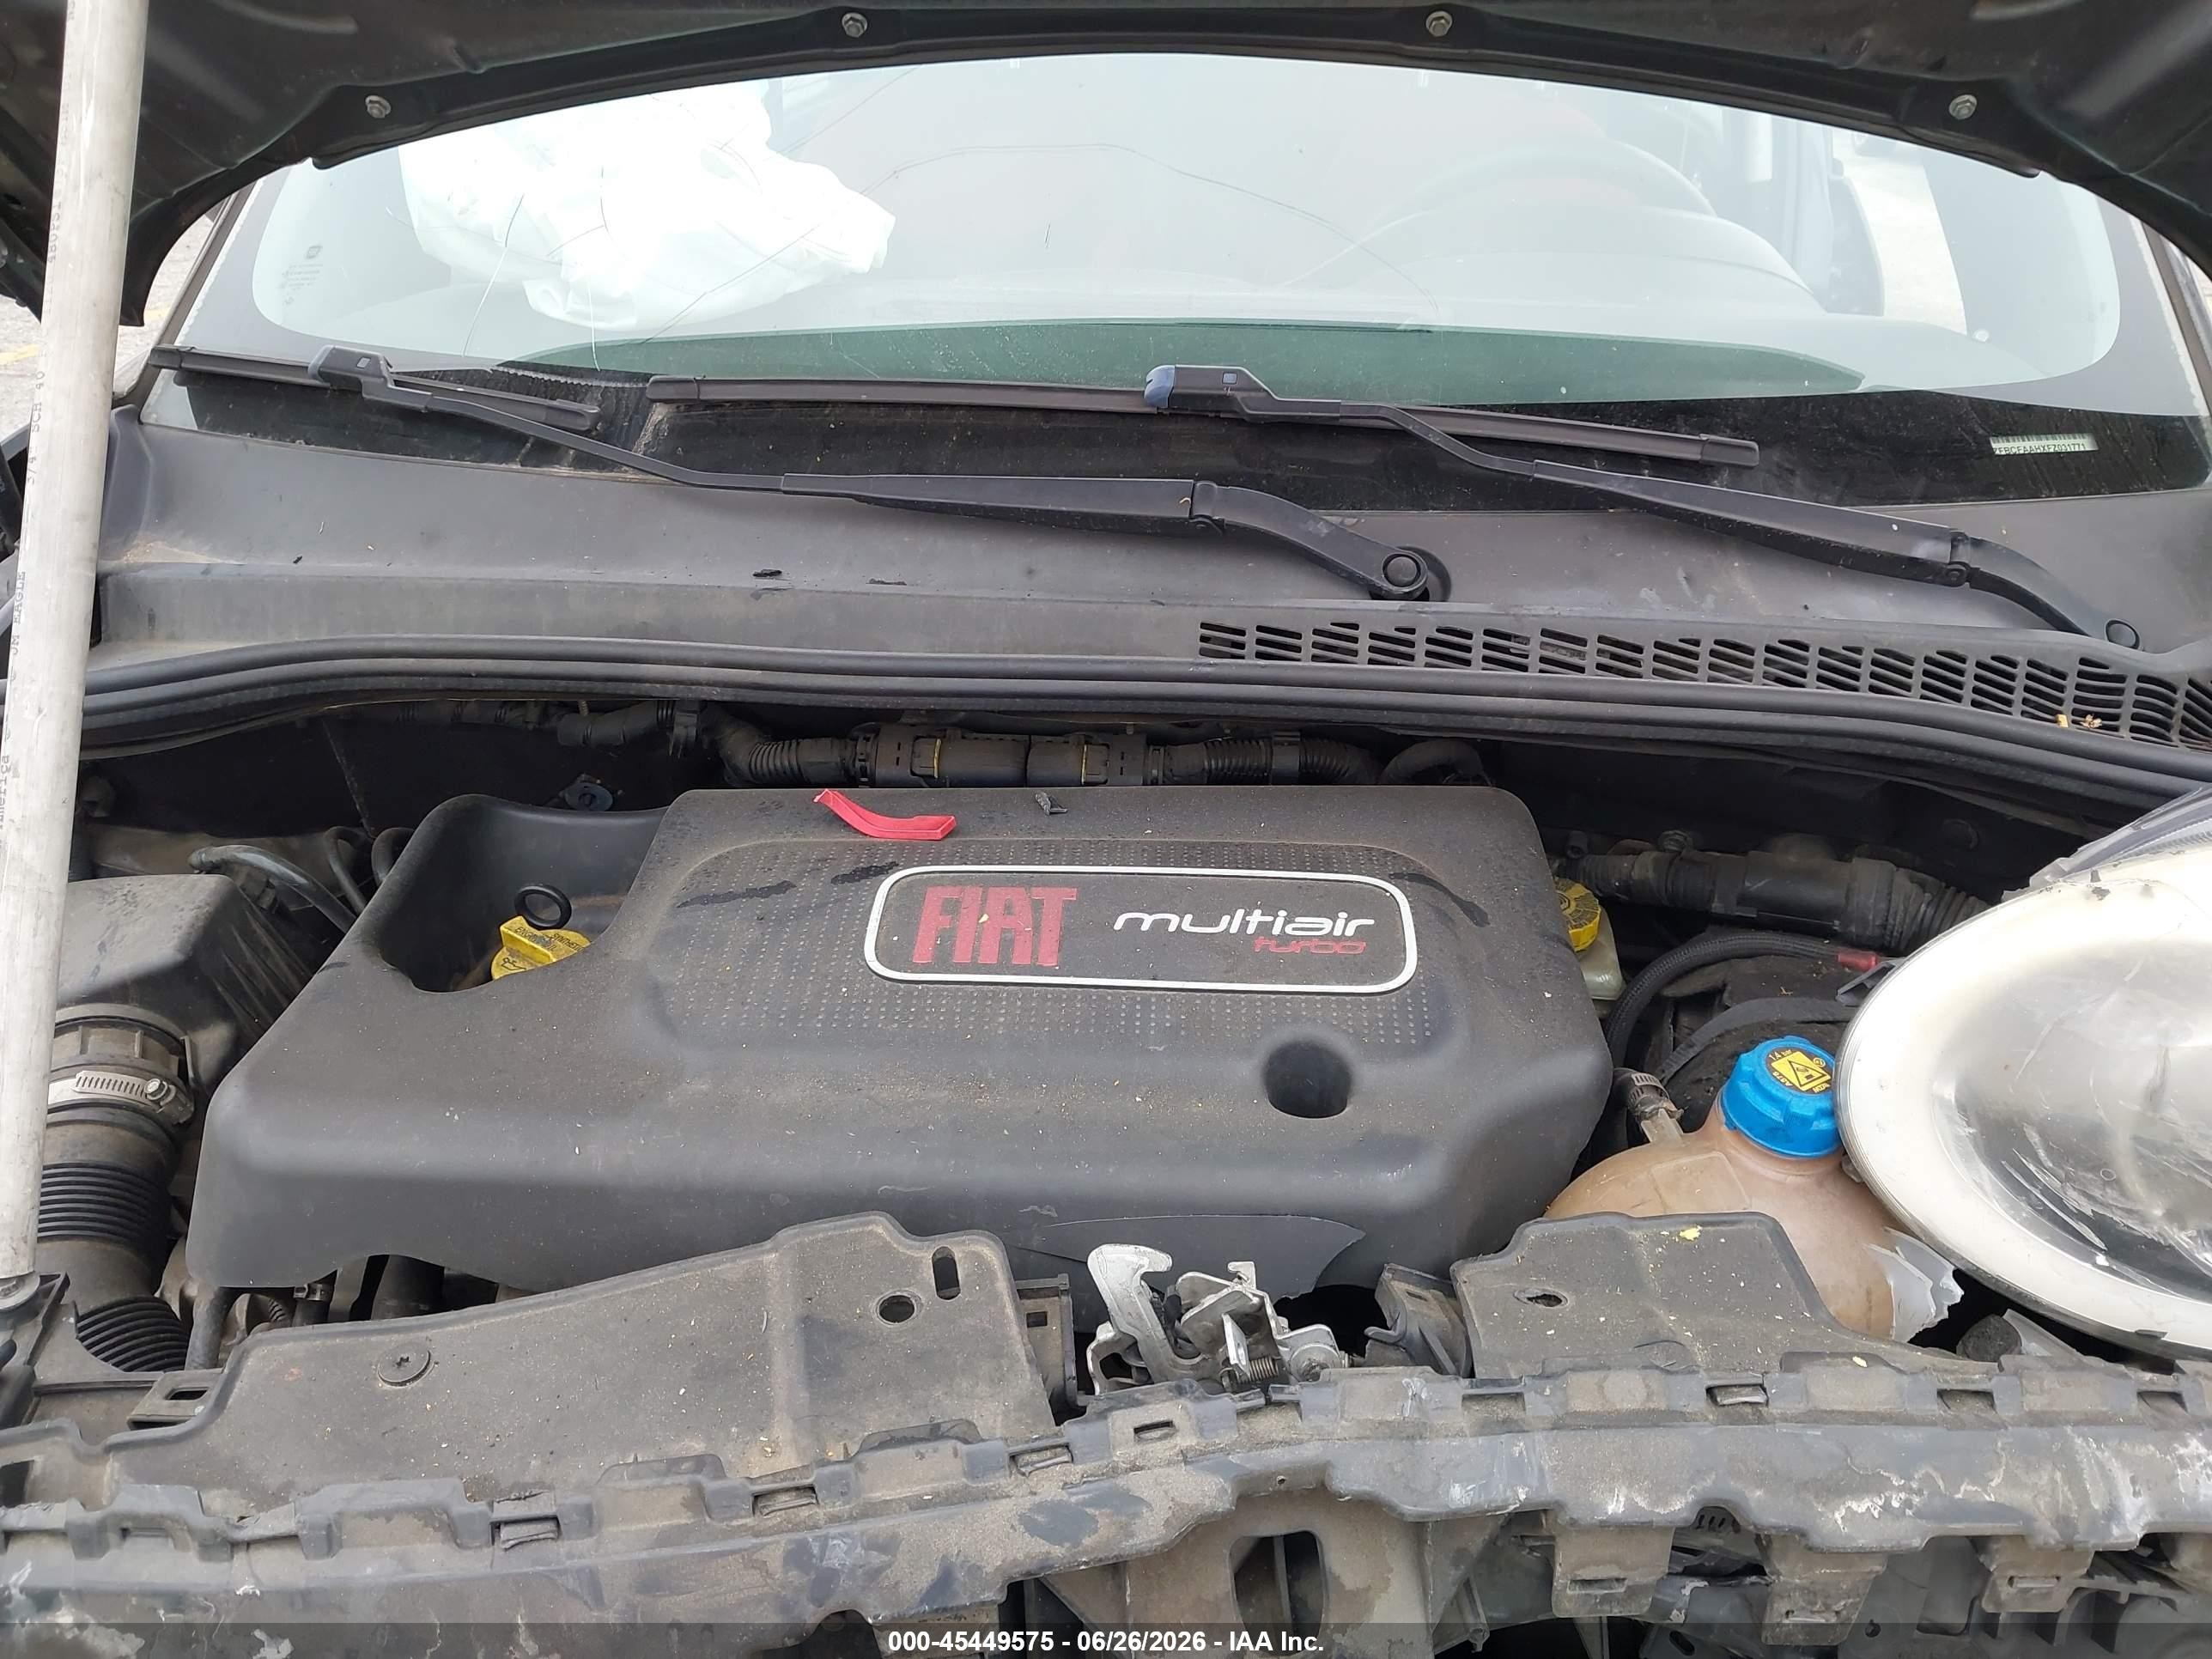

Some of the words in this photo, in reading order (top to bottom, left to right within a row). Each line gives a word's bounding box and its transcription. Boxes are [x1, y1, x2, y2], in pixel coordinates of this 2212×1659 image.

[13, 570, 26, 624] EAGLE
[31, 401, 42, 433] SCH
[910, 884, 1078, 967] FIAT
[1113, 906, 1376, 937] multiair
[1252, 936, 1366, 955] turbo
